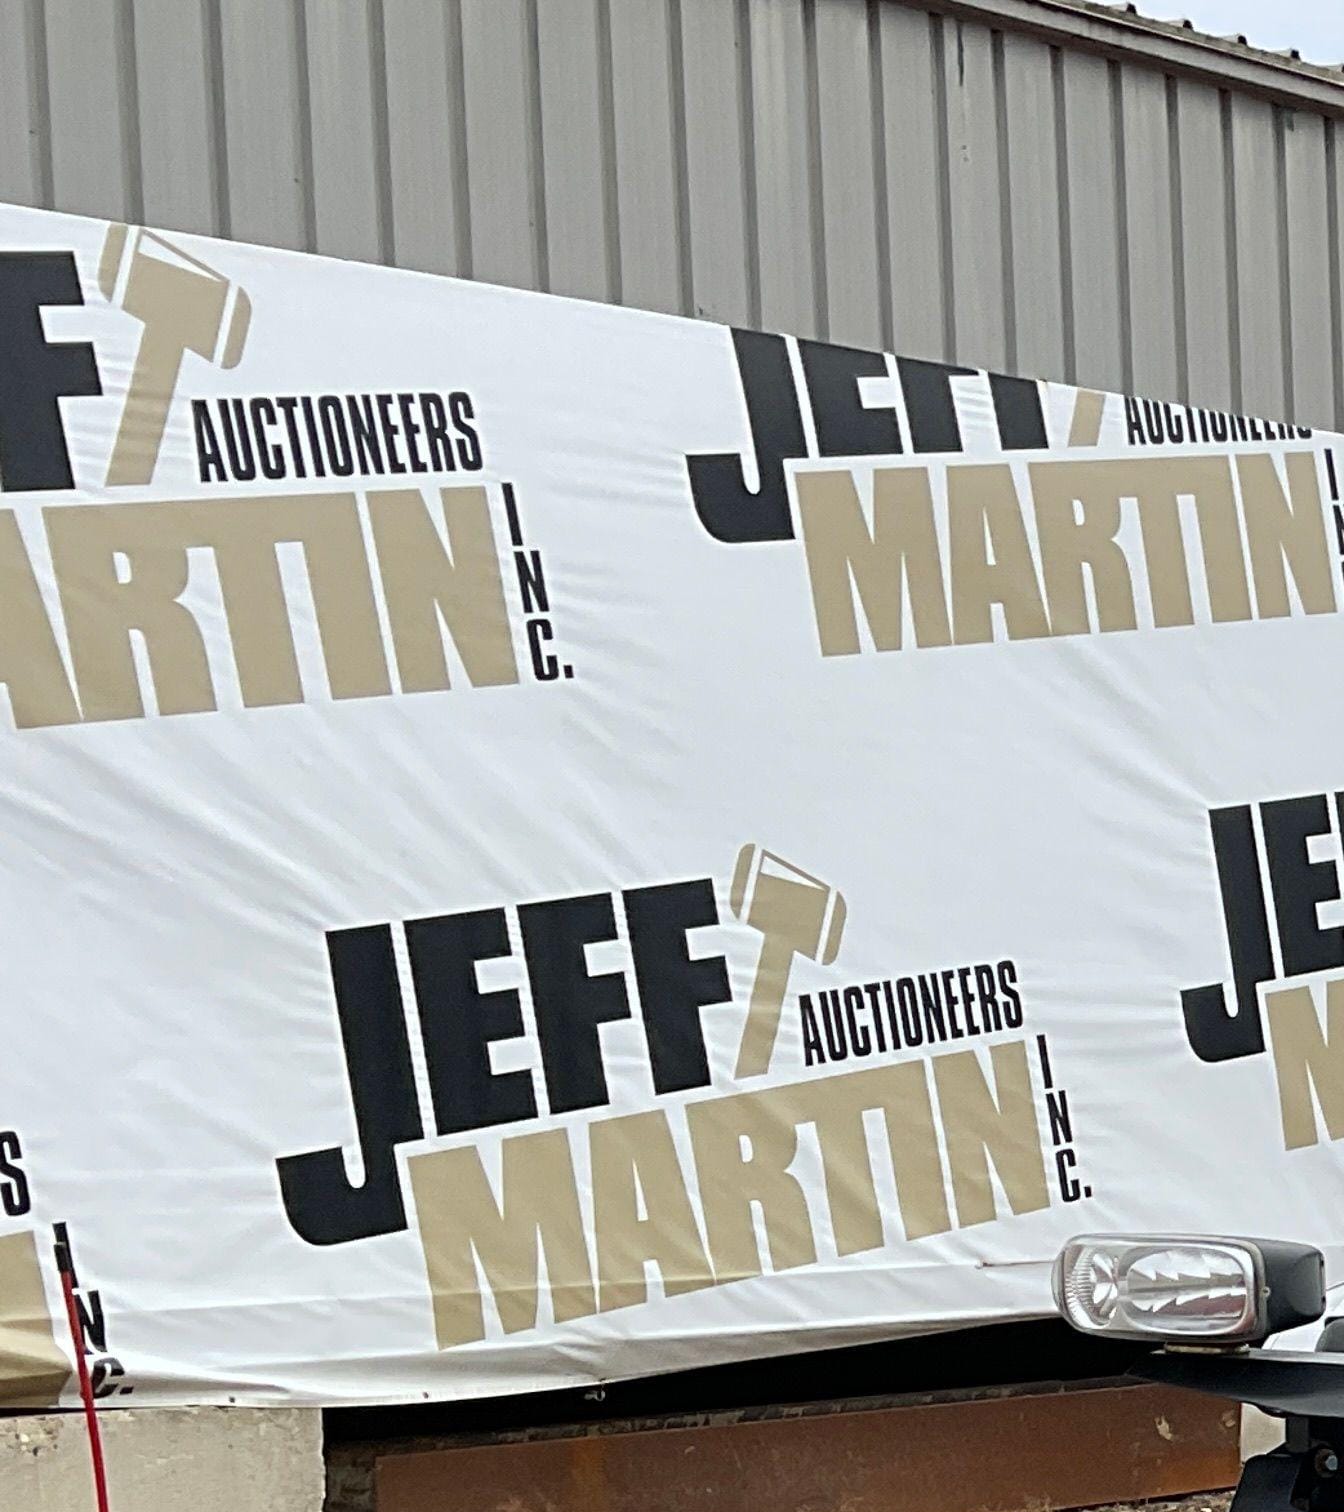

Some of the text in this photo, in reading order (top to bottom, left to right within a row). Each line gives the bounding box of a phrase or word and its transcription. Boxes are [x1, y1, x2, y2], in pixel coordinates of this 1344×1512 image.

[191, 391, 484, 482] AUCTIONEERS
[501, 482, 575, 681] INC.
[794, 451, 1338, 657] MARTIN
[275, 878, 733, 1246] JEFF
[798, 960, 1023, 1067] AUCTIONEERS
[406, 1040, 1051, 1350] MARTIN
[1039, 1034, 1092, 1203] INC.
